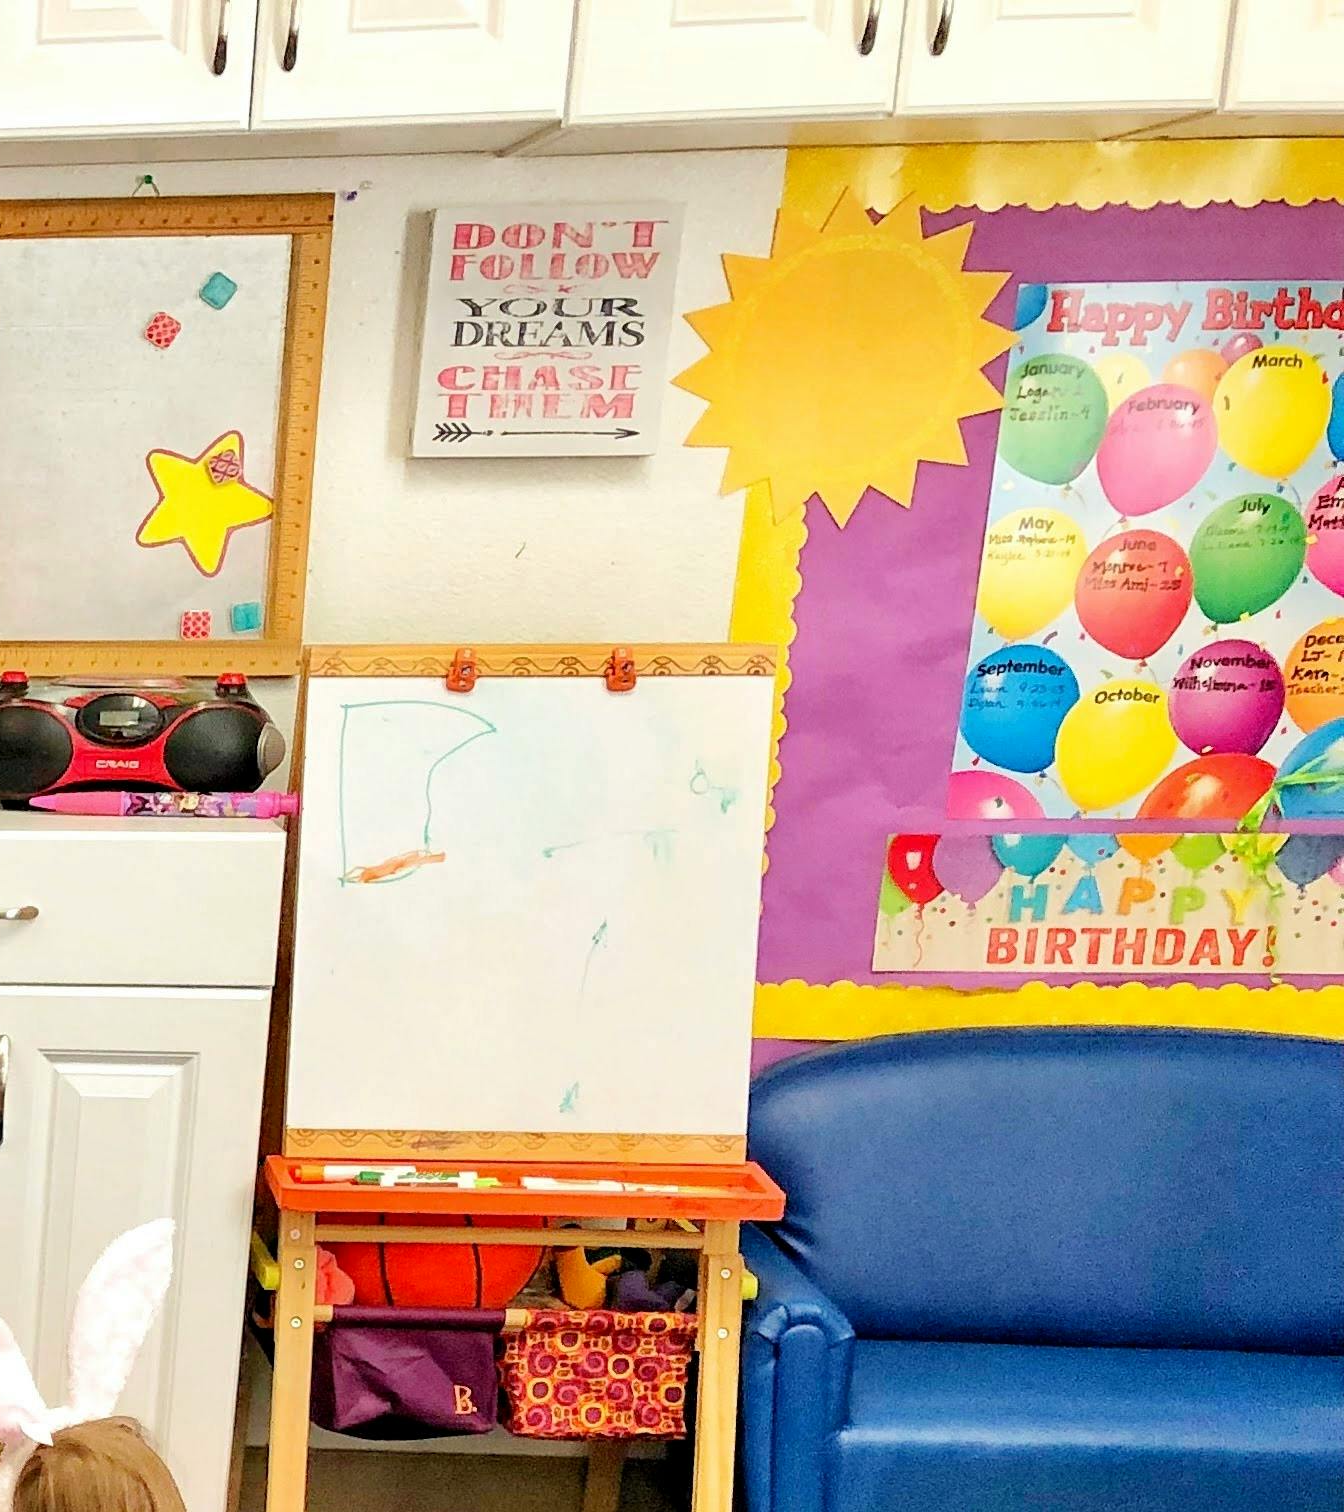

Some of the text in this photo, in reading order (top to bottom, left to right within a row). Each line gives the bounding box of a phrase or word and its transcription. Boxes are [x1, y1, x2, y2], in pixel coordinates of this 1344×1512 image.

[452, 220, 669, 250] DON'T
[449, 252, 661, 281] FOLLOW
[457, 297, 645, 318] YOUR
[1047, 289, 1191, 347] Happy
[450, 320, 645, 347] DREAMS
[437, 365, 641, 391] CHASE
[1021, 354, 1303, 379] January March
[438, 393, 638, 419] THEM
[1128, 400, 1199, 415] February
[1019, 498, 1271, 532] May July
[1119, 538, 1157, 552] June
[977, 654, 1277, 678] September November
[1094, 688, 1160, 704] October
[96, 760, 139, 770] CRAIG
[1010, 876, 1255, 926] HAPPY
[986, 926, 1276, 967] BIRTHDAY!
[453, 1384, 478, 1415] B.
